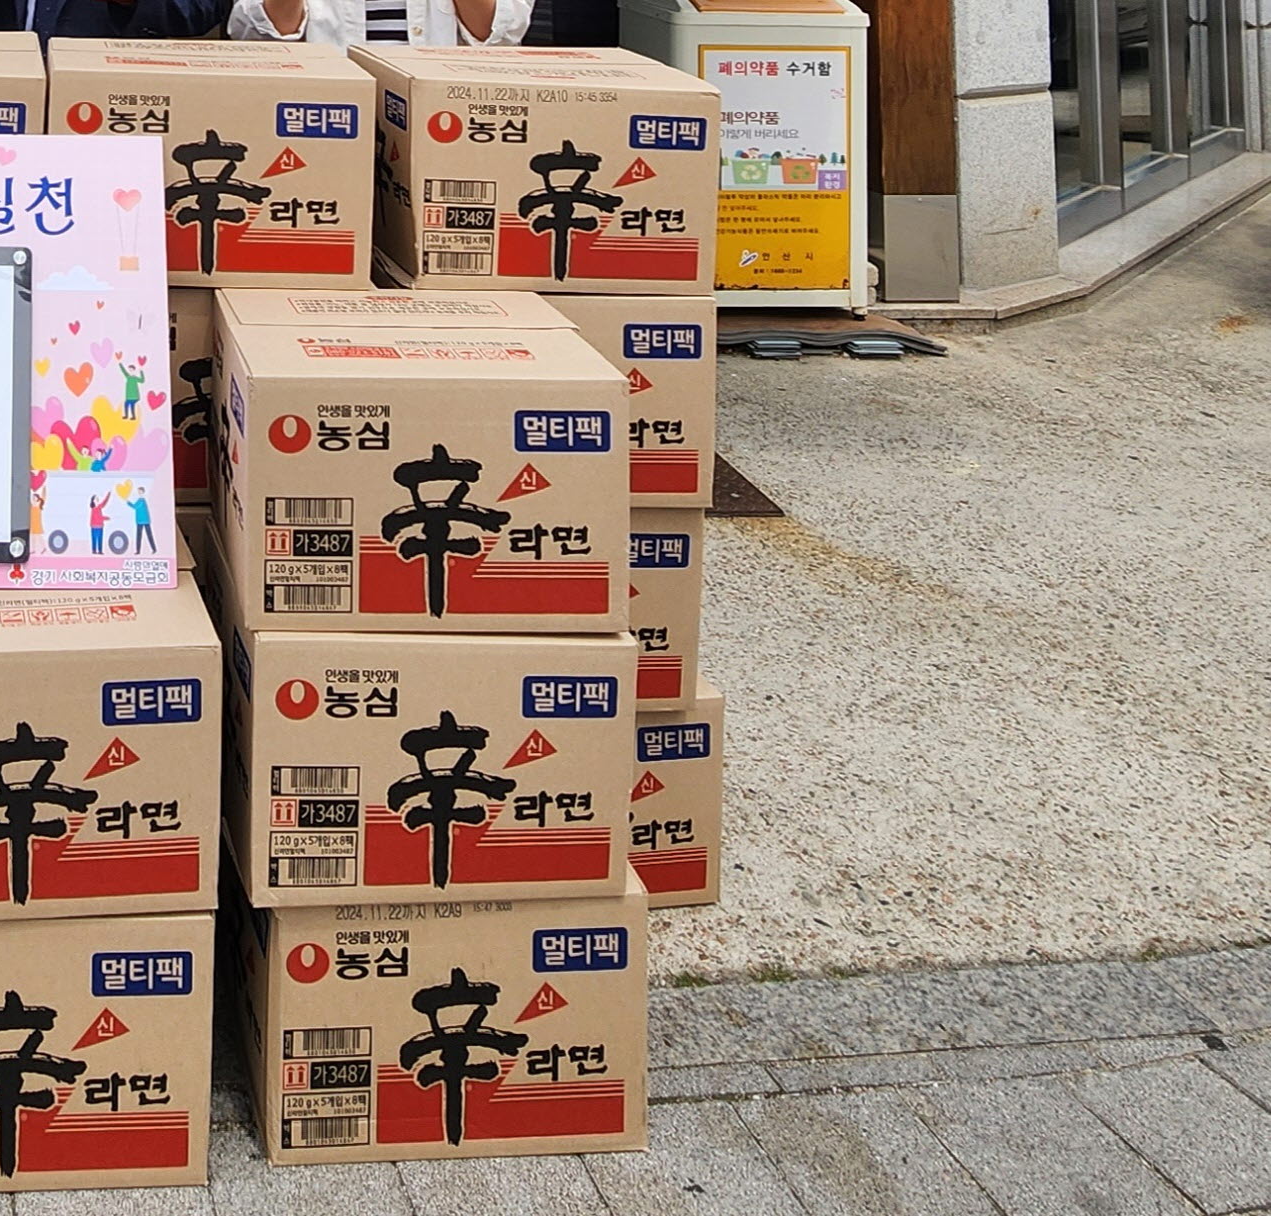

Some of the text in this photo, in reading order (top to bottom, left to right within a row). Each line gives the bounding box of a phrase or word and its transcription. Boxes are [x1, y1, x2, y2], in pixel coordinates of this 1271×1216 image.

[718, 61, 832, 76] 폐의약품 수거함
[536, 89, 568, 103] K2A10
[107, 107, 170, 136] 농심
[283, 106, 351, 135] 멀티팩
[467, 116, 528, 146] 농심
[636, 118, 700, 147] 멀티팩
[755, 129, 800, 139] 버리세요
[165, 127, 341, 278] 辛 라면
[447, 208, 493, 228] 가3487
[516, 137, 687, 283] 辛 라면
[631, 329, 695, 355] 멀티팩
[316, 420, 390, 453] 농심
[523, 415, 602, 448] 멀티팩
[295, 531, 350, 554] 가3487
[380, 443, 592, 619] 辛 라면
[31, 570, 170, 586] 경기 사회복지공동모금회
[111, 685, 193, 719] 멀티팩
[324, 685, 398, 720] 농심
[531, 679, 609, 713] 멀티팩
[644, 728, 704, 757] 멀티팩
[387, 709, 595, 888] 辛 라면
[640, 777, 653, 794] 신
[96, 799, 182, 839] 라면
[301, 802, 356, 825] 가3487
[632, 818, 695, 850] 라면
[335, 947, 409, 980] 농심
[541, 933, 619, 966] 멀티팩
[101, 957, 183, 990] 멀티팩
[399, 967, 608, 1146] 辛 라면
[313, 1062, 368, 1086] 가3487
[84, 1072, 171, 1111] 라면
